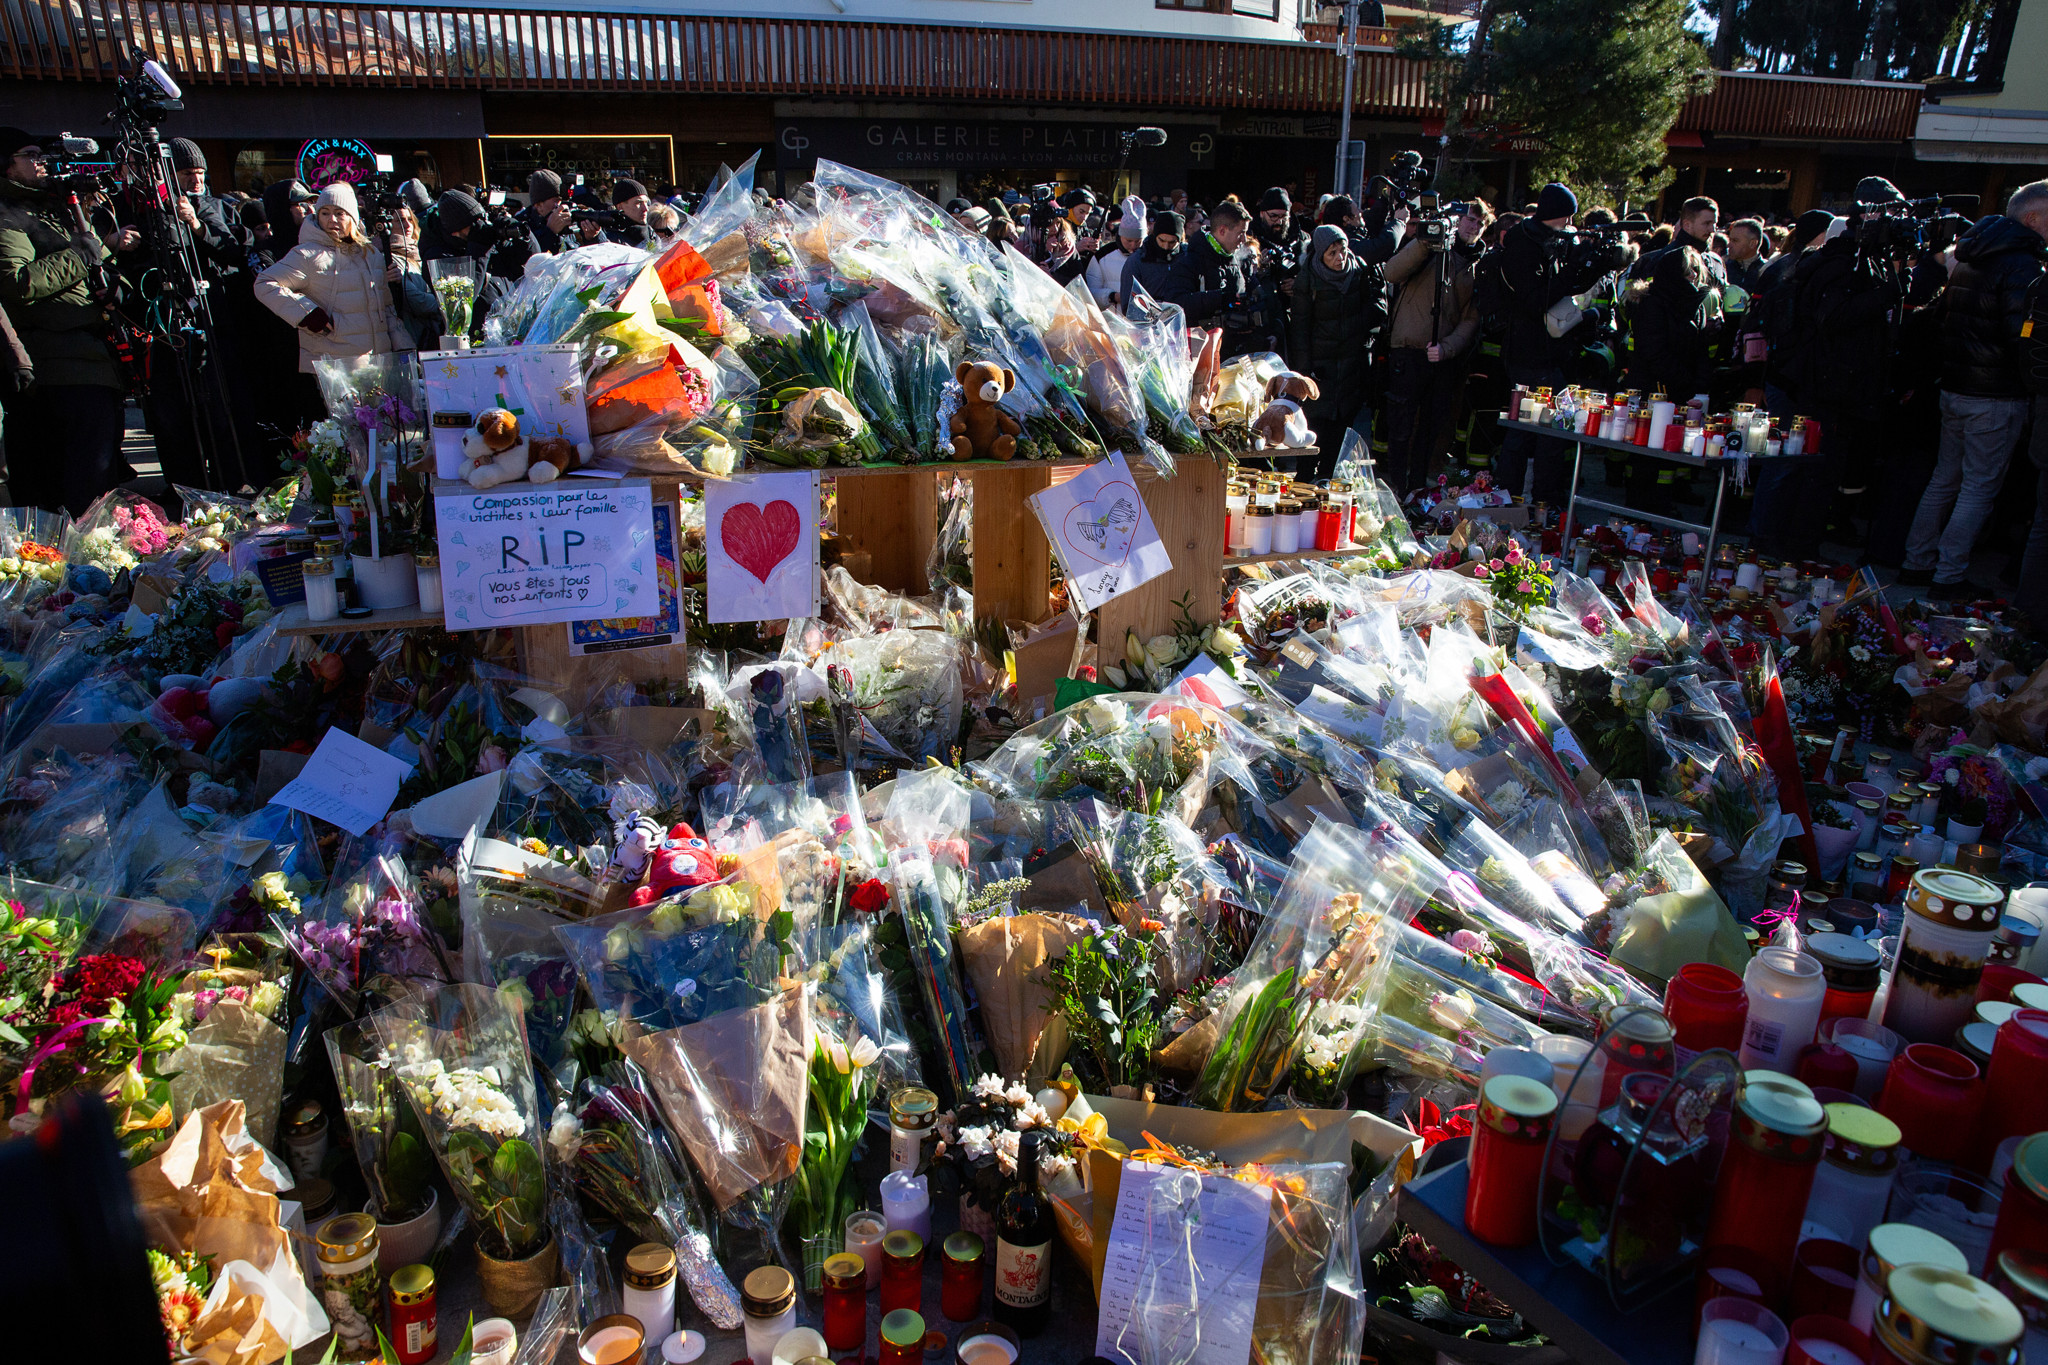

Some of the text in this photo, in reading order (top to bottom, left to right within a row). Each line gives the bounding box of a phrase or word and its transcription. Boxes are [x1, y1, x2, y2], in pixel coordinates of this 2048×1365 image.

[866, 125, 999, 146] GALERIE
[308, 139, 367, 159] MAX & MAX
[896, 151, 1116, 163] CRANS MONTANA LYON ANNECY
[316, 151, 357, 169] Tiny
[310, 166, 369, 189] Diner
[469, 510, 523, 522] victimes
[575, 503, 618, 520] famille
[473, 494, 553, 513] Compassion
[557, 494, 582, 508] pour
[524, 578, 555, 589] êtes
[560, 573, 590, 586] tous
[494, 588, 573, 604] nos enfants
